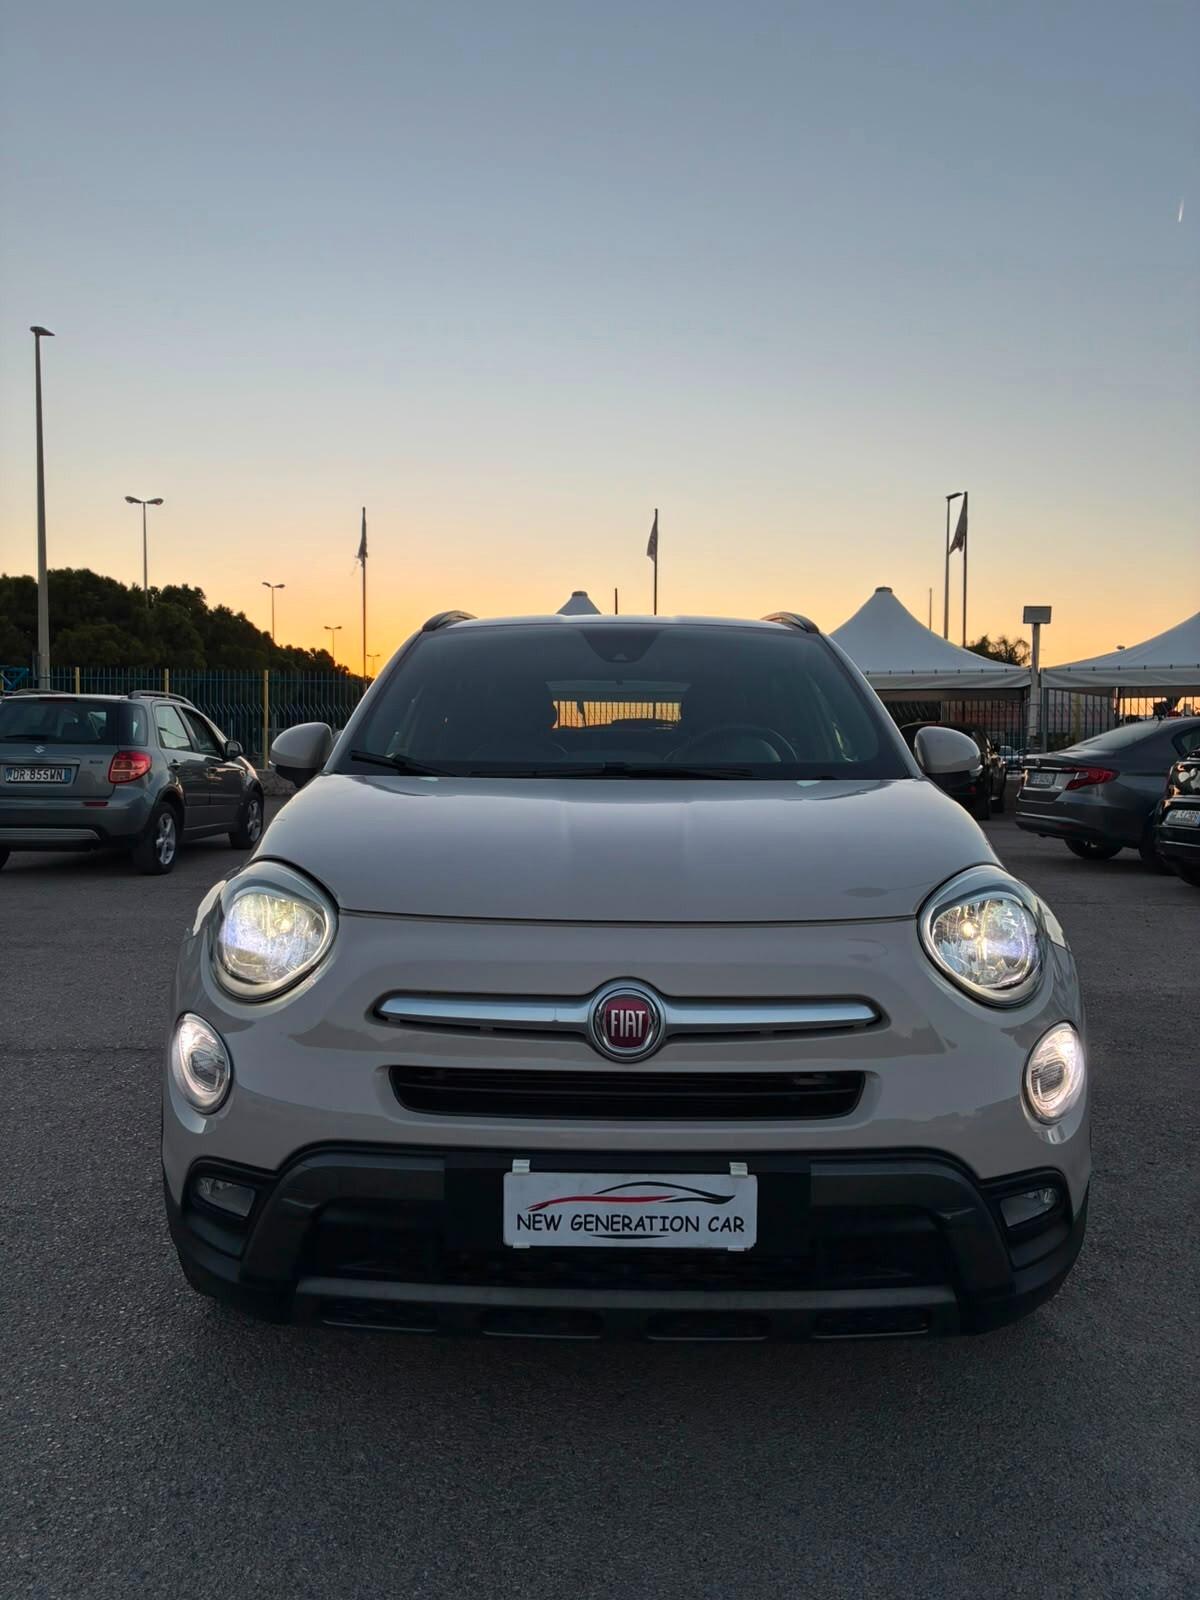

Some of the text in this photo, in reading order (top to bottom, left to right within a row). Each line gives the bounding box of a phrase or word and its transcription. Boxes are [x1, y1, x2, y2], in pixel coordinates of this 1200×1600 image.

[611, 1010, 646, 1038] FIAT
[516, 1213, 745, 1233] NEW GENERATION CAR
